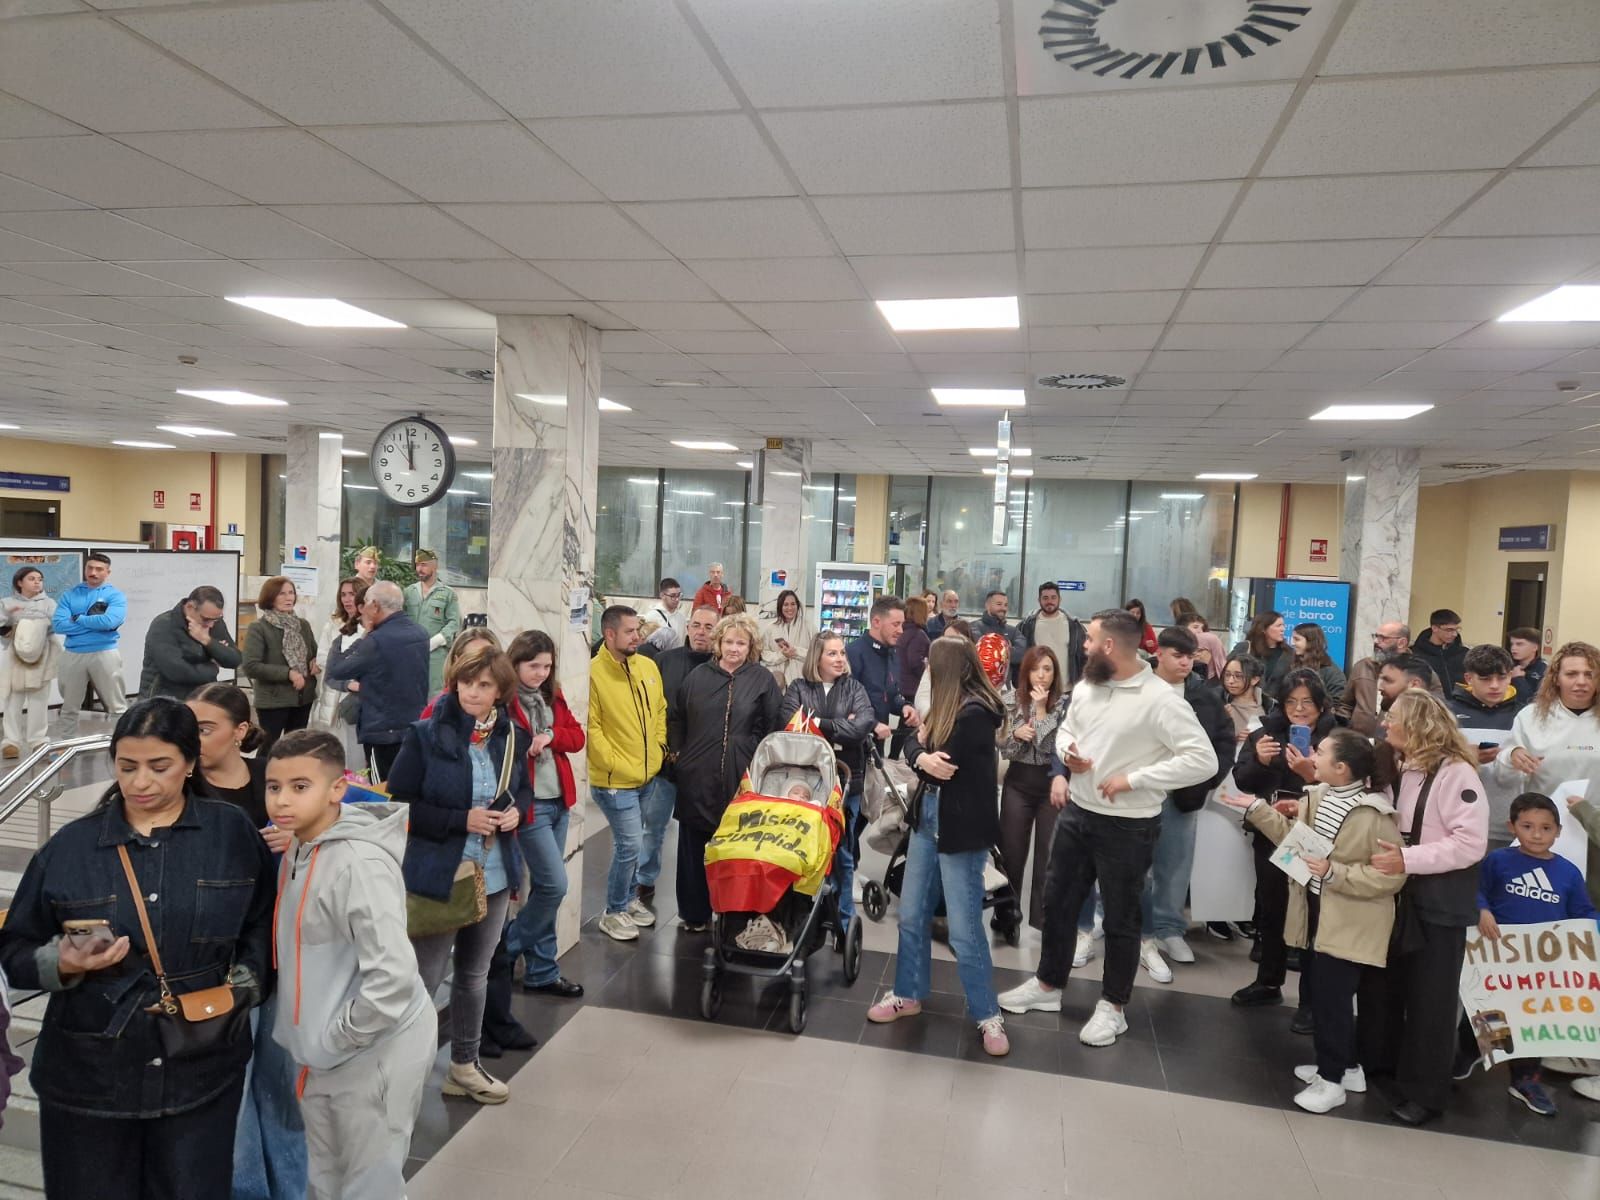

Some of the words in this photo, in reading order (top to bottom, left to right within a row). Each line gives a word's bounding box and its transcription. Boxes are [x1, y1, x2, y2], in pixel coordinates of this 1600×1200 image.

[393, 433, 402, 441] 11
[384, 444, 394, 453] 10
[432, 443, 440, 452] 2
[380, 458, 388, 467] 9
[434, 459, 442, 467] 3
[383, 472, 392, 481] 8
[430, 473, 439, 481] 4
[395, 484, 403, 492] 7
[421, 484, 430, 493] 5
[407, 488, 416, 498] 6
[1282, 596, 1297, 606] Tu
[1300, 597, 1337, 608] billete
[1282, 609, 1296, 618] de
[1299, 610, 1334, 621] barco
[736, 809, 812, 836] Misión
[1505, 883, 1560, 904] adidas
[1466, 924, 1597, 965] MISIÓN
[1484, 970, 1600, 991] CUMPLIDA
[1522, 995, 1595, 1015] CABO
[1520, 1023, 1600, 1043] MALQU
